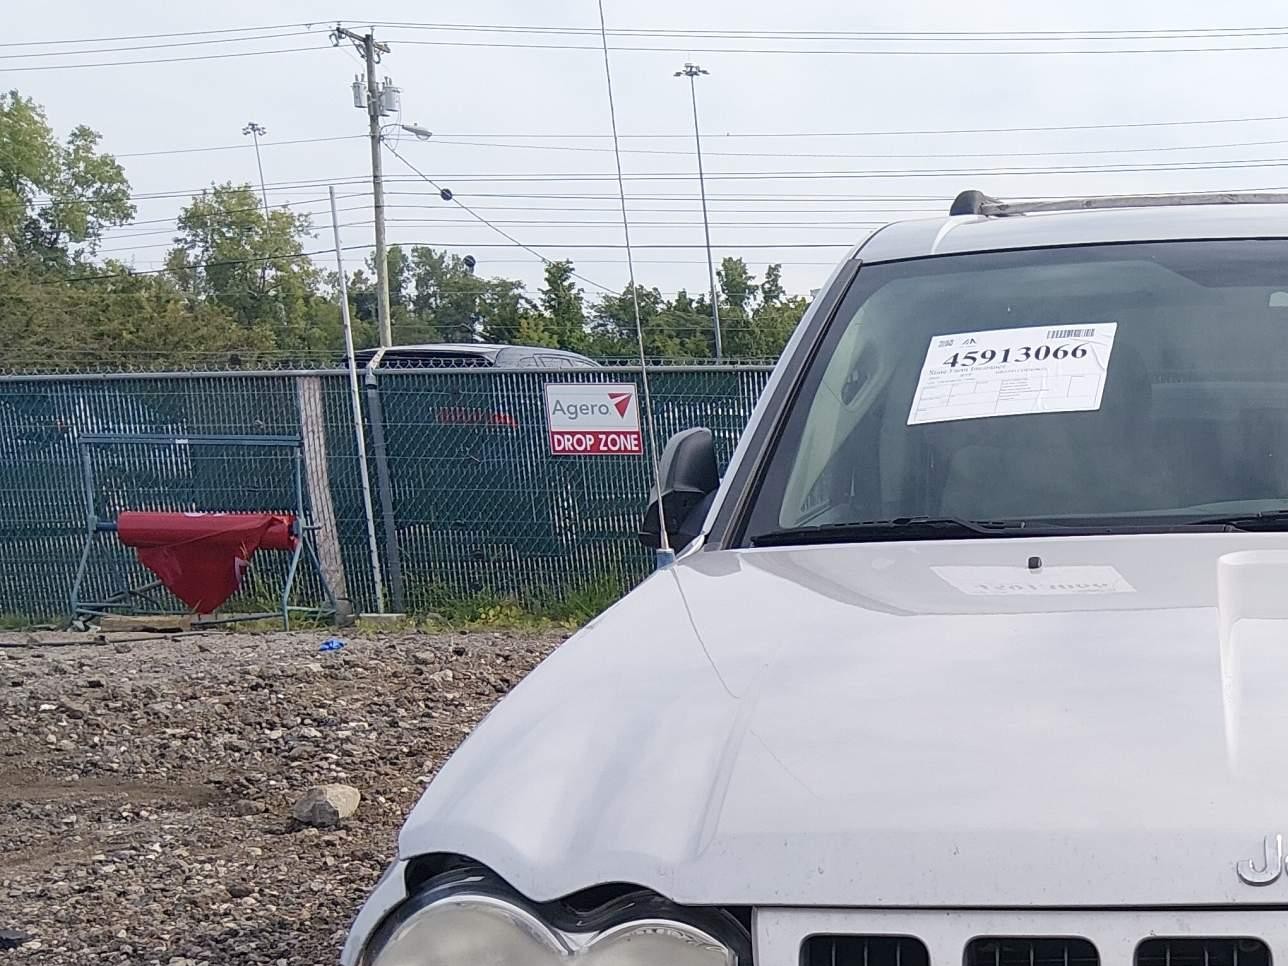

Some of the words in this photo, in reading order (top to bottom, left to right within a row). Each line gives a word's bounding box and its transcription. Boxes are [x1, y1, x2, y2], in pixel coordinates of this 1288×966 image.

[942, 342, 1089, 368] 45913066
[552, 400, 610, 420] Agero
[553, 434, 595, 451] DROP
[598, 434, 640, 451] ZONE
